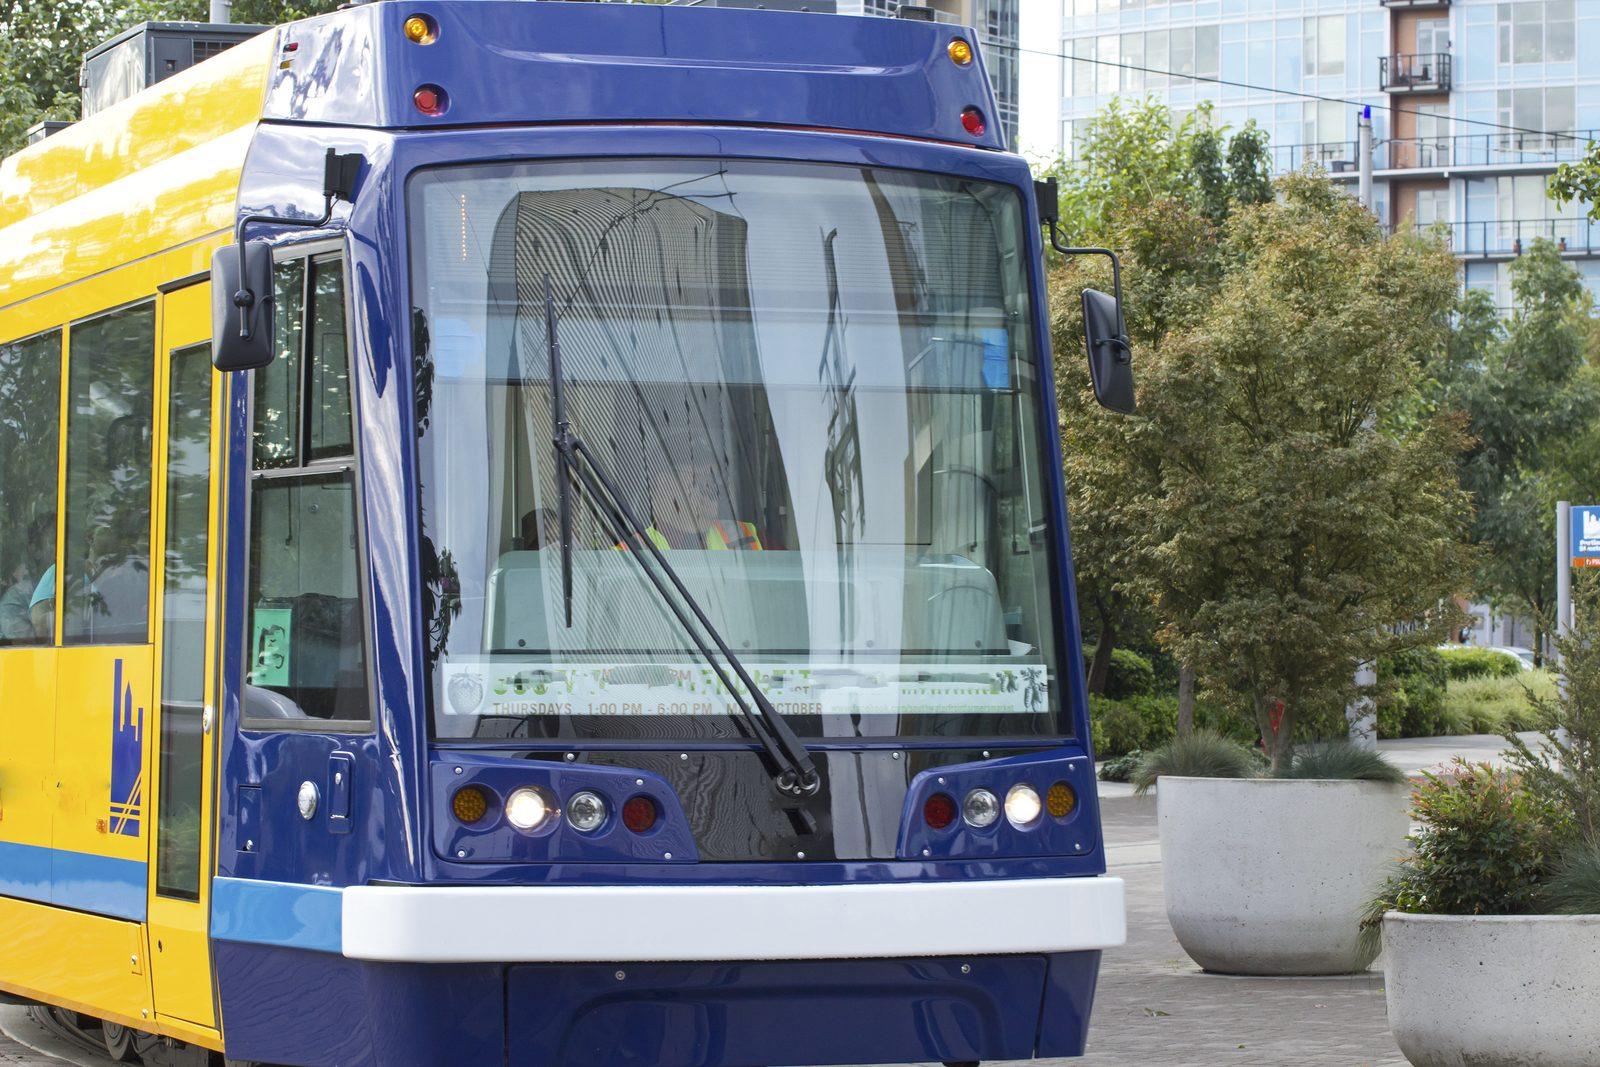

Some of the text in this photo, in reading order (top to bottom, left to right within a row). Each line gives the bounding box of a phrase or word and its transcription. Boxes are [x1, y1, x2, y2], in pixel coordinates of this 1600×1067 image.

[493, 702, 572, 715] THURSDAYS
[588, 702, 617, 715] 1:00
[622, 702, 642, 715] PM
[657, 702, 688, 715] 6:00
[692, 702, 713, 715] PM
[726, 702, 753, 715] MY
[768, 702, 823, 715] CTOBER
